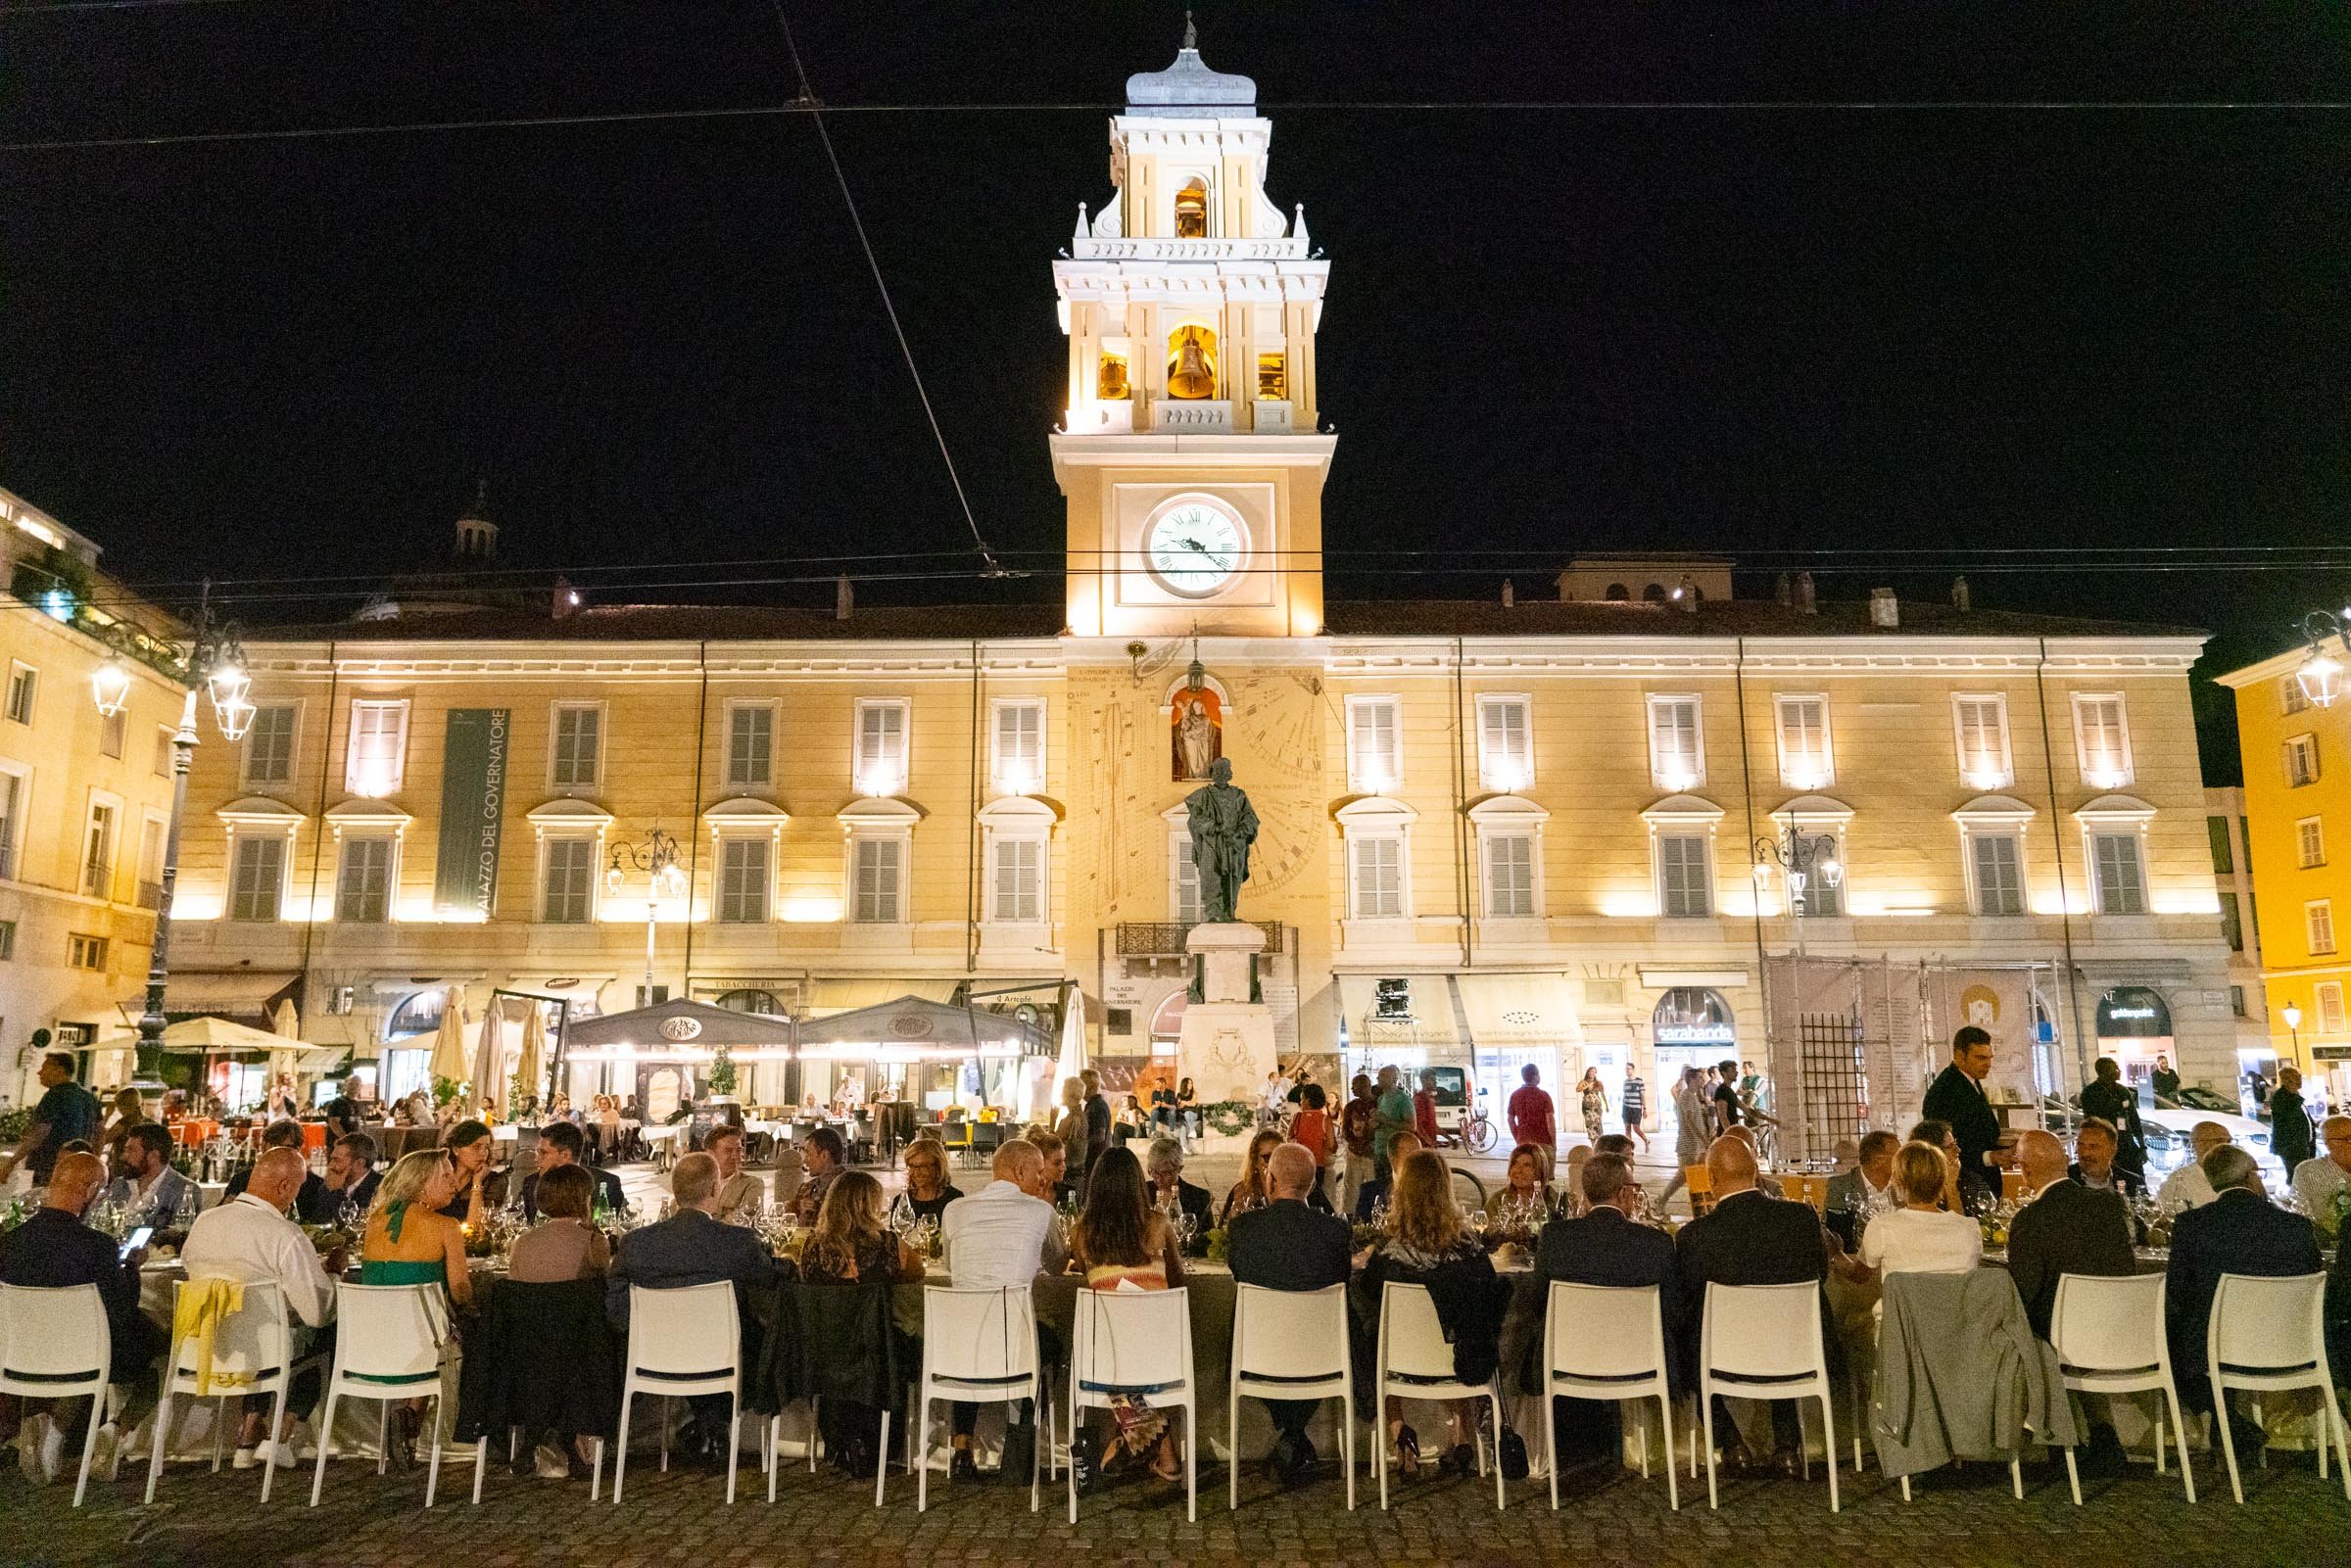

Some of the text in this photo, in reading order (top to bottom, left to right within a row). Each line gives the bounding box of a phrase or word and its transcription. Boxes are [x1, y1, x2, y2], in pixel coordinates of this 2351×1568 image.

[483, 709, 506, 820] GOVERNATORE
[482, 822, 497, 847] DEL
[714, 979, 776, 988] TABACCHERIA
[2110, 1008, 2155, 1020] goldenpoint
[1657, 1023, 1732, 1039] sarabanda
